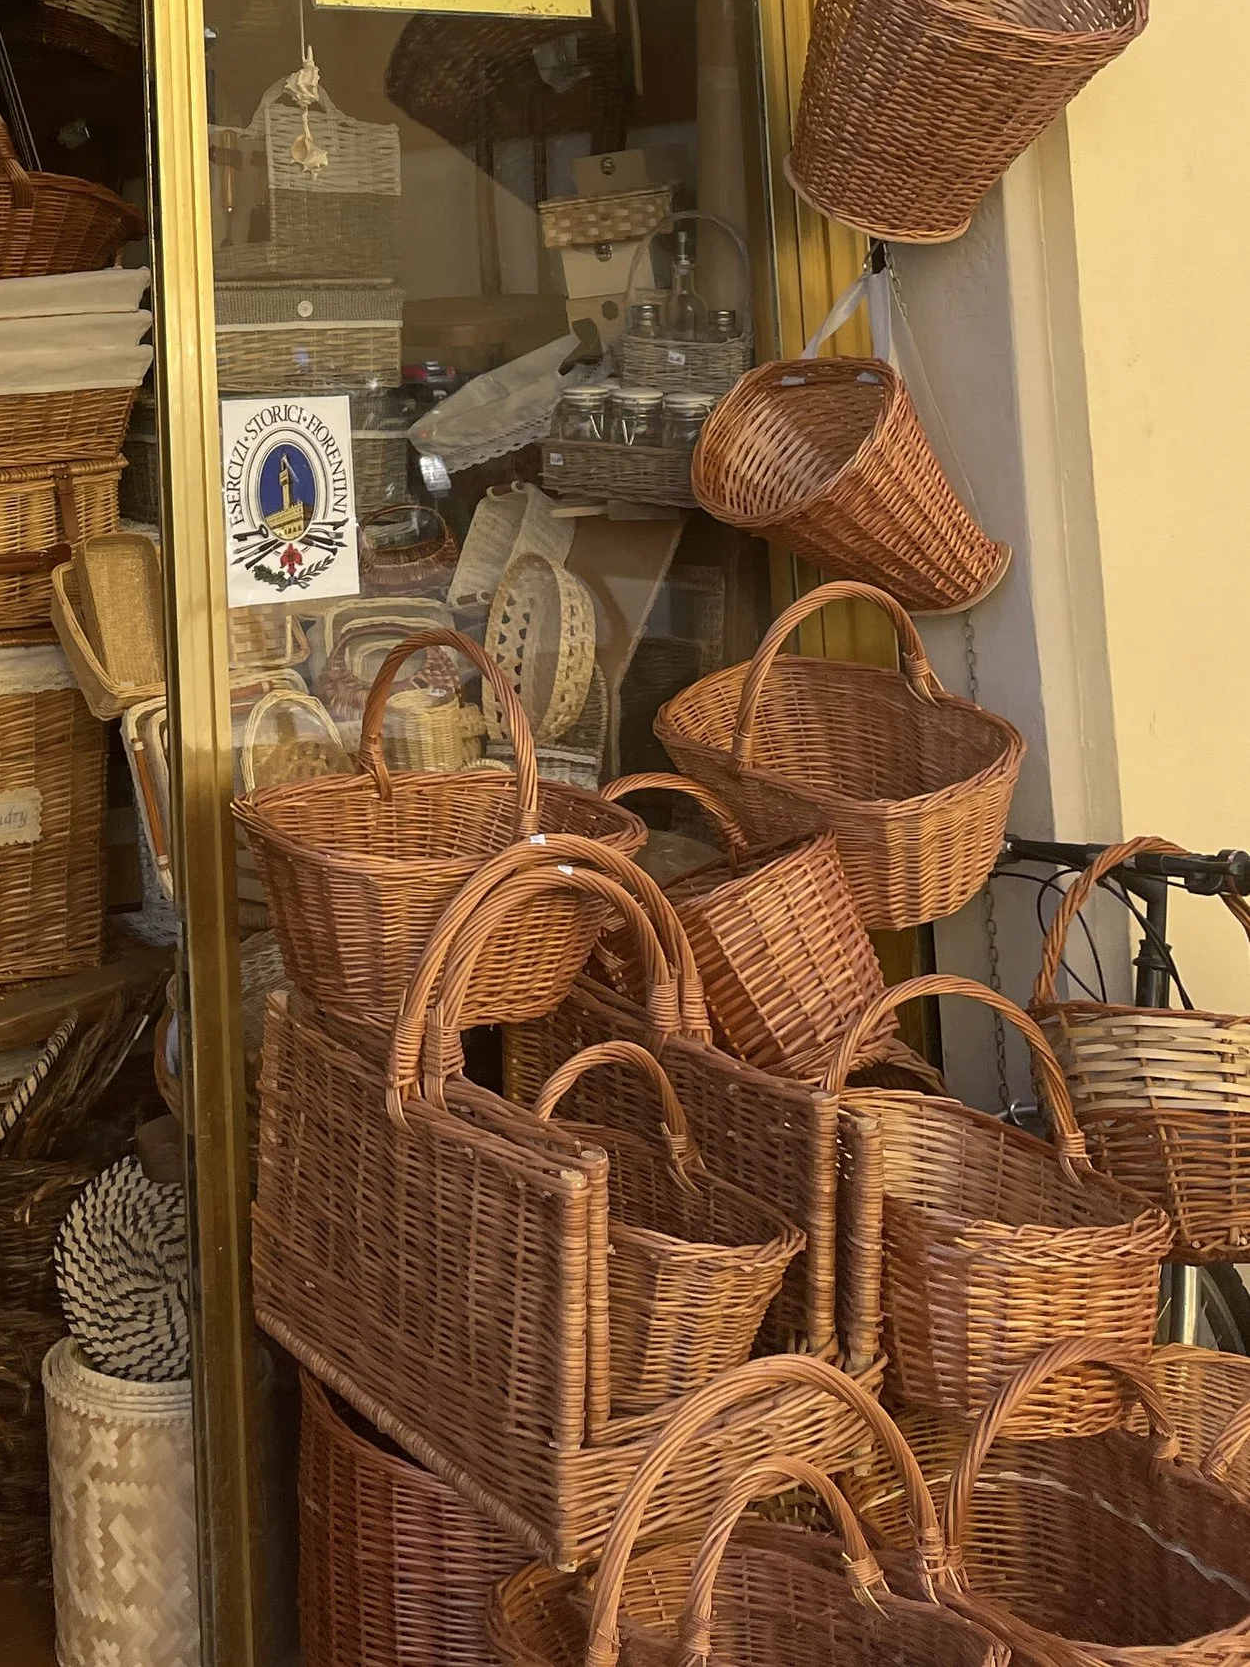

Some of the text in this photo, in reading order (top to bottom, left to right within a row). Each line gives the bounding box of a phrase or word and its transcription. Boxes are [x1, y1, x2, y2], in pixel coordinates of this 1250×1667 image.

[225, 403, 348, 529] ESERCIZI STORICI FIORENTINI
